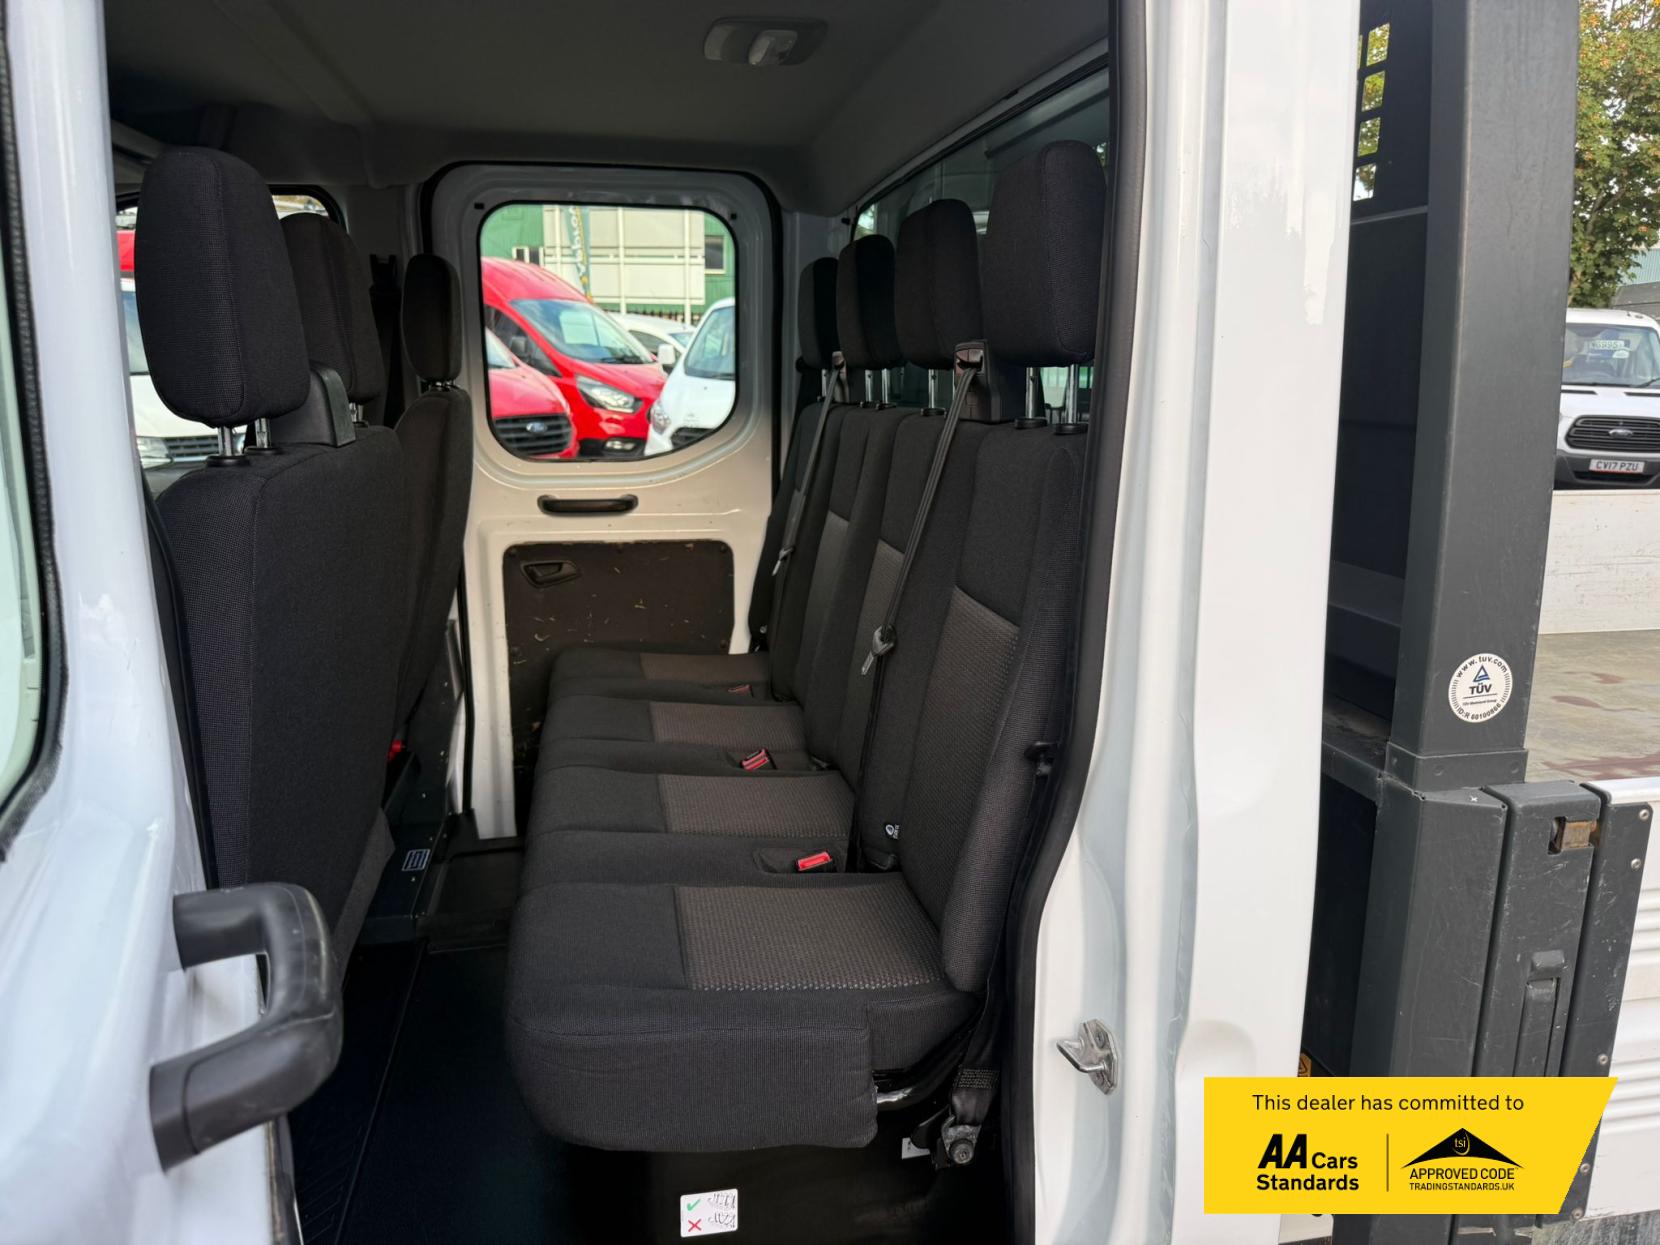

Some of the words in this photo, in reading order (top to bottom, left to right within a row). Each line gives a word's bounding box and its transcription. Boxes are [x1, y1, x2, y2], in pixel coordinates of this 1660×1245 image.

[1595, 460, 1617, 470] CV17
[1619, 462, 1639, 471] PZU
[1469, 682, 1492, 695] TÜV
